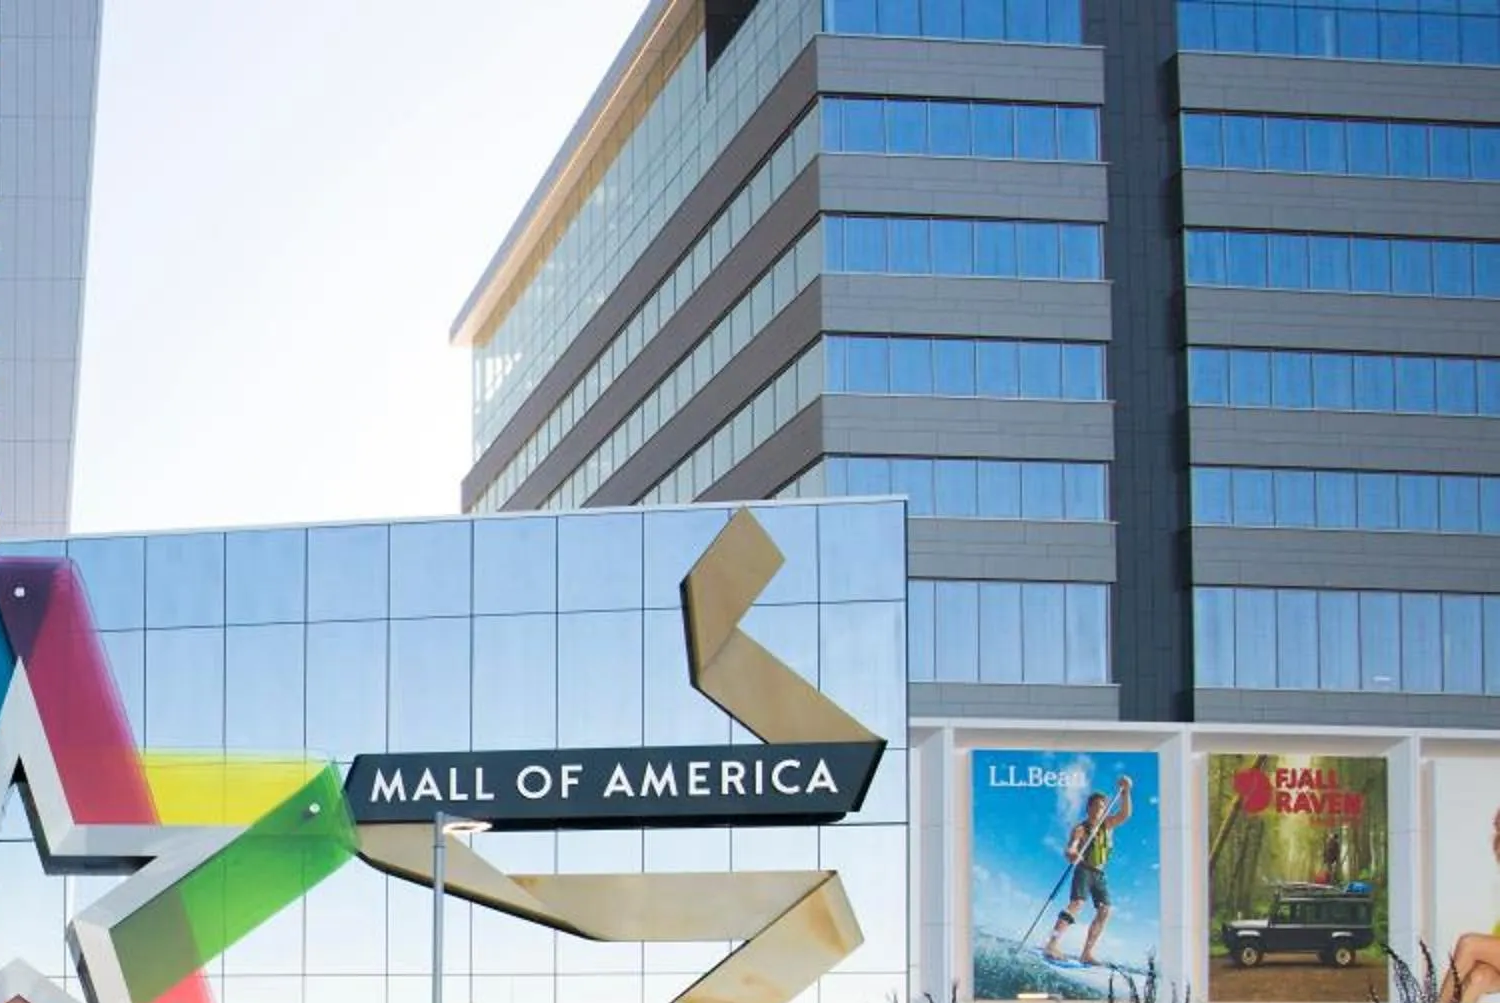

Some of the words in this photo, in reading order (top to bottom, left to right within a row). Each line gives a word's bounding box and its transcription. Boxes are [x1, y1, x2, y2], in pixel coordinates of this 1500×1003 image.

[370, 766, 496, 804] MALL
[516, 764, 584, 800] OF
[603, 758, 839, 798] AMERICA
[988, 765, 1087, 788] L.L.Bean
